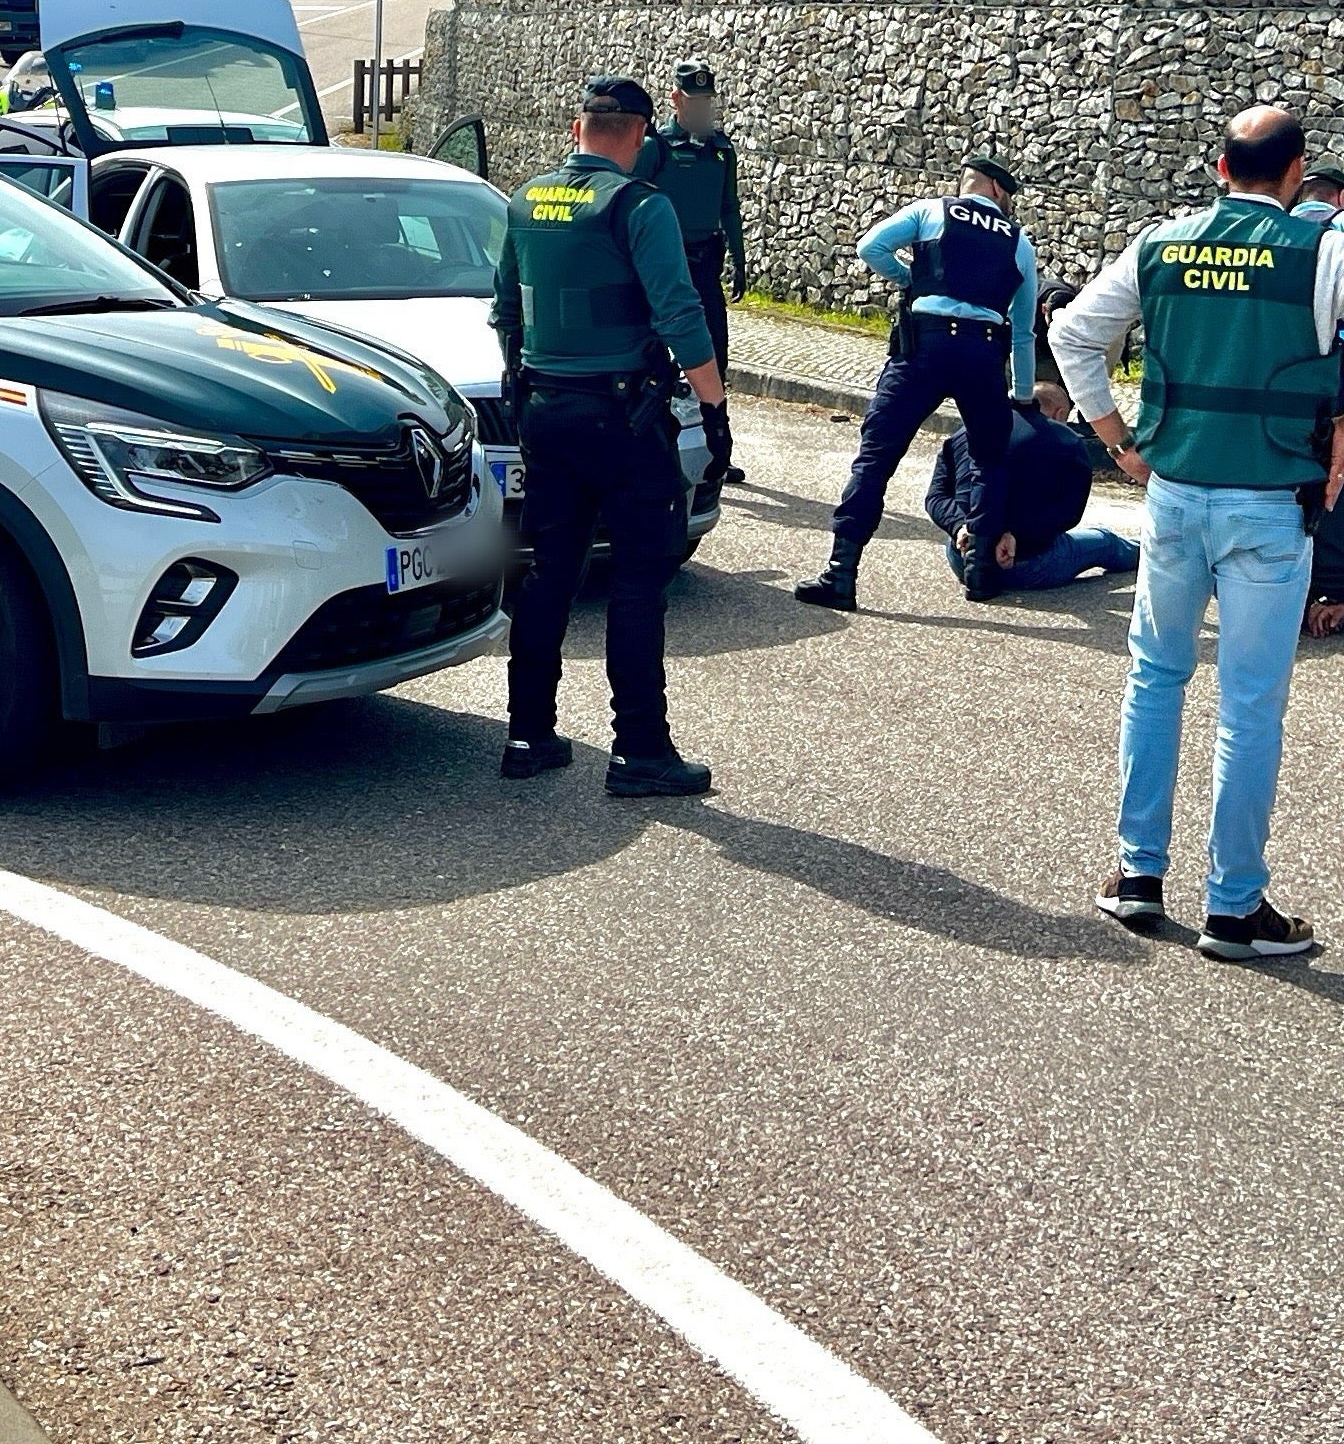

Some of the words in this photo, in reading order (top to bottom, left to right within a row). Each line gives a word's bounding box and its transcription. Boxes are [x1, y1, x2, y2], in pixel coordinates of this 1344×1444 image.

[526, 187, 595, 203] GUARDIA
[533, 204, 573, 222] CIVIL
[949, 205, 1012, 237] GNR
[1162, 245, 1274, 268] GUARDIA
[1184, 269, 1249, 291] CIVIL
